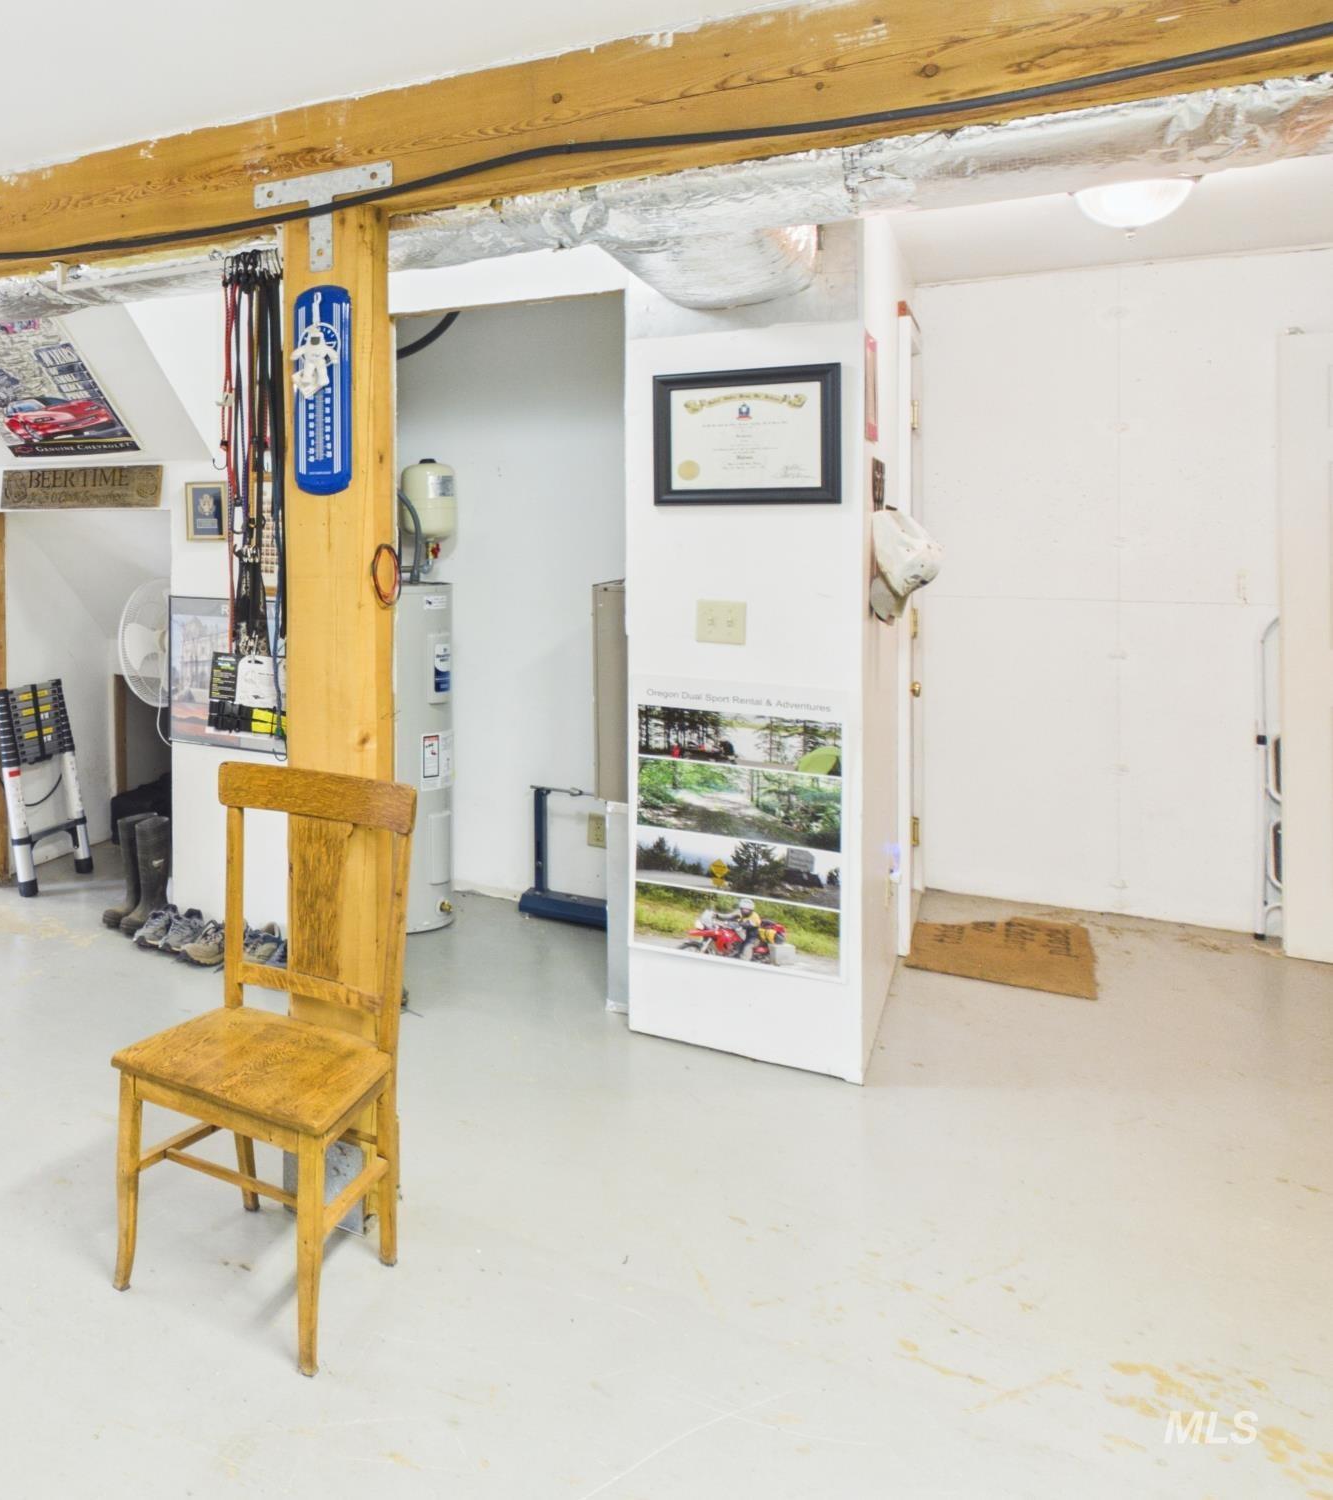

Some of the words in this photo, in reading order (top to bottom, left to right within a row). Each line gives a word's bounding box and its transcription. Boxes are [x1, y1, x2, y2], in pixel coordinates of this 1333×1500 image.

[77, 442, 132, 450] CHEVROLET
[28, 470, 75, 488] BEER
[78, 467, 129, 487] TIME
[647, 688, 679, 699] Oregon
[681, 691, 703, 700] Dual
[706, 693, 729, 703] Sport
[732, 696, 763, 706] Rental
[776, 700, 832, 712] Adventures
